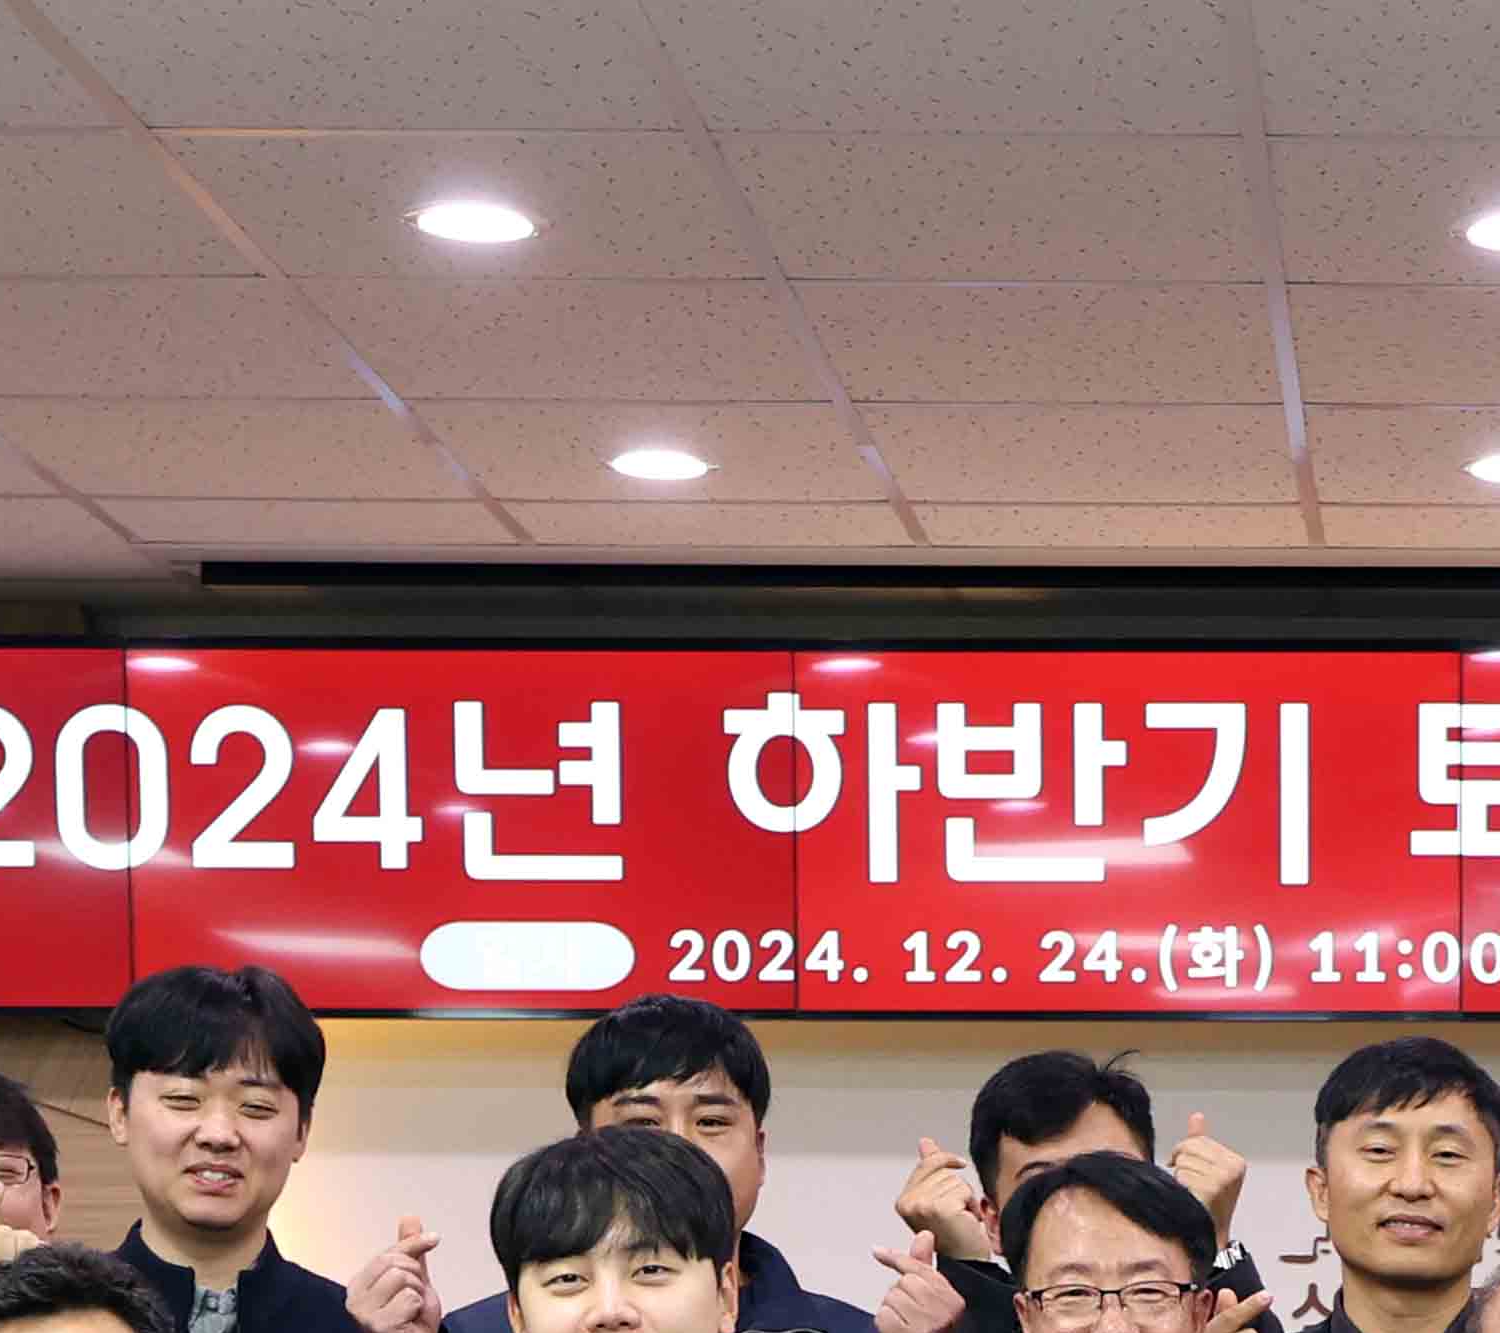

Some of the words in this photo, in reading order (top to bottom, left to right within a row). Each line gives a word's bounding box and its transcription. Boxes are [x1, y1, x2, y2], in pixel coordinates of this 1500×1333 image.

[722, 691, 1310, 886] 하반기
[668, 929, 869, 983] 2024.
[903, 930, 1008, 983] 12.
[1039, 924, 1273, 993] 24.(화)
